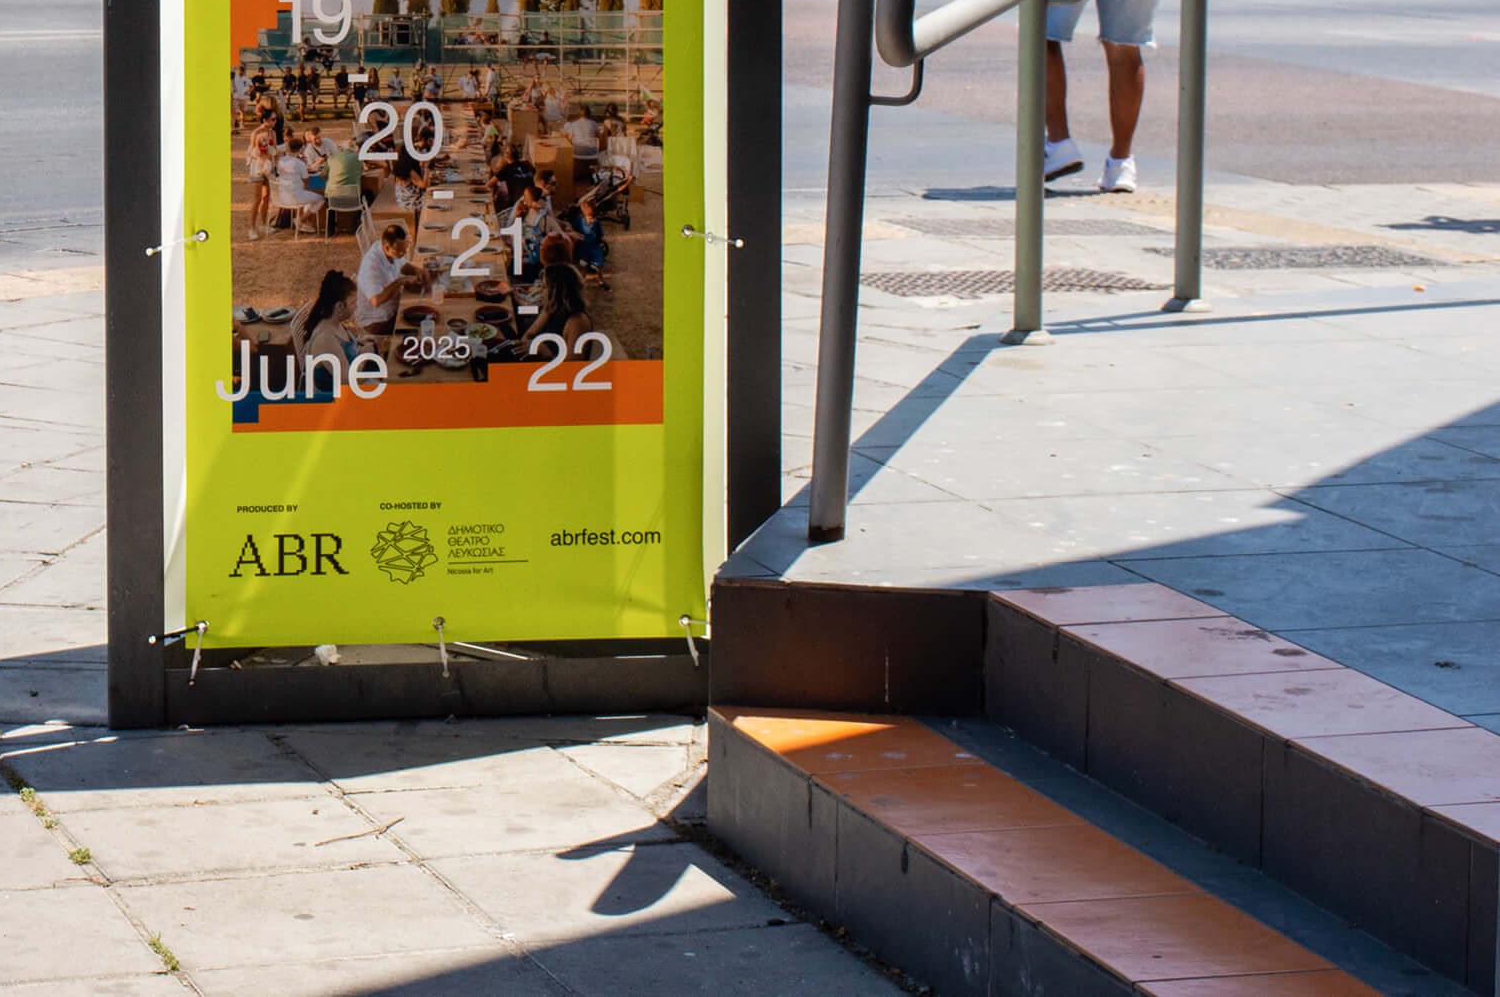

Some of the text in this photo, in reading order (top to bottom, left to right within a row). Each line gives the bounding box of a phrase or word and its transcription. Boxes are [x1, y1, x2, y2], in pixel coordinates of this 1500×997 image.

[358, 102, 443, 161] 20
[450, 217, 523, 276] 21
[216, 332, 613, 403] June 2025 22
[237, 504, 297, 513] PRODUCED BY
[380, 501, 441, 510] CO-HOSTED BY
[448, 523, 505, 535] ΔΗΜΟΤΙΚΟ
[448, 536, 489, 546] ΘΕΑΤΡΟ
[550, 528, 661, 546] abrfest.com
[229, 533, 349, 577] ABR
[473, 566, 481, 574] for
[484, 566, 493, 574] Art
